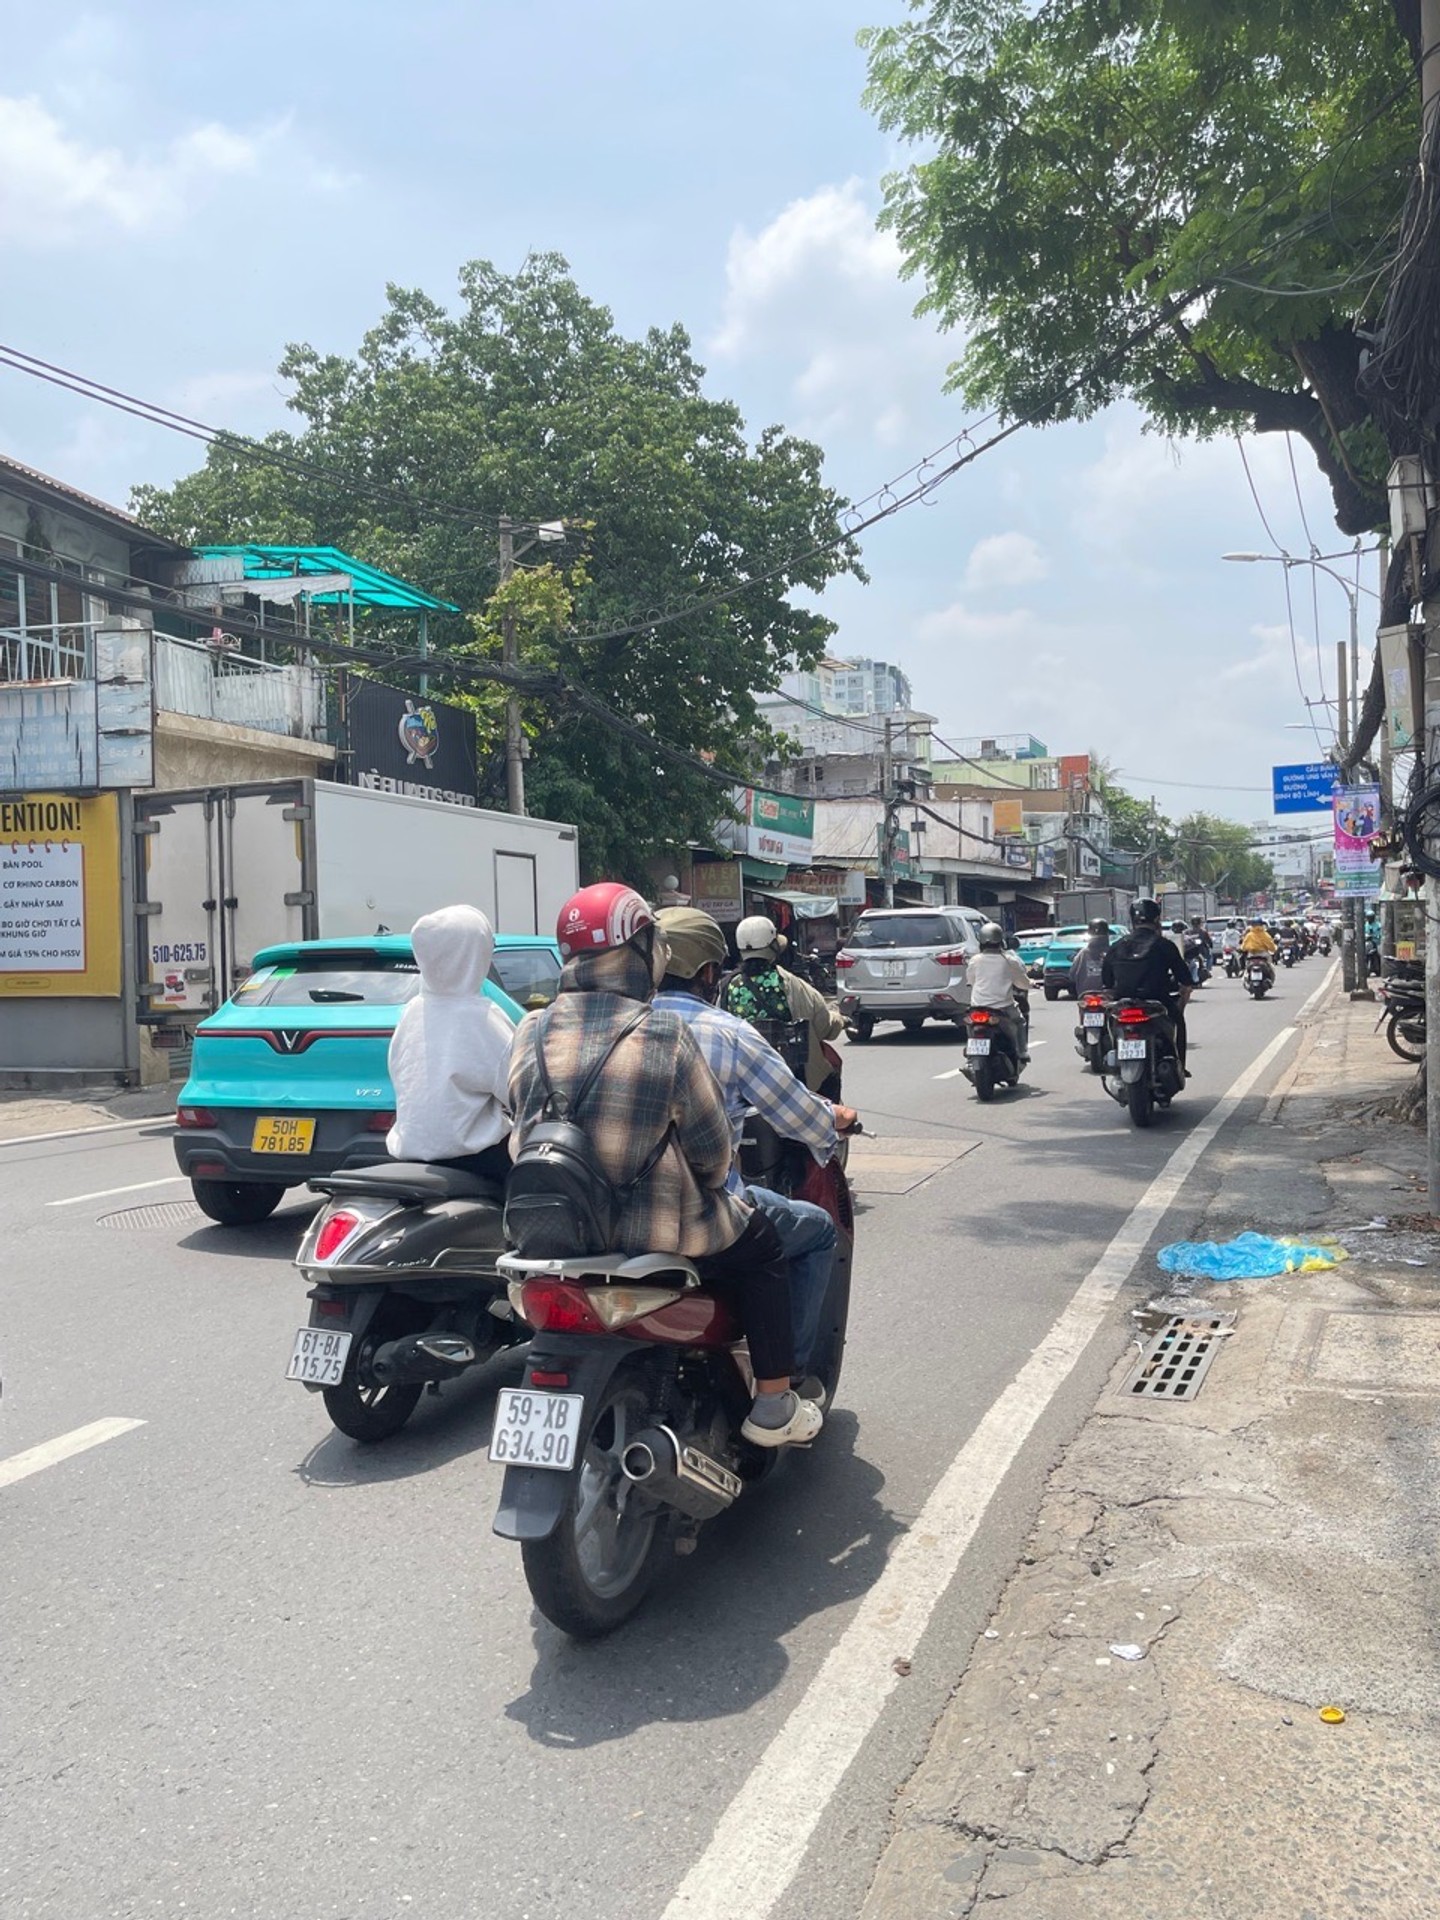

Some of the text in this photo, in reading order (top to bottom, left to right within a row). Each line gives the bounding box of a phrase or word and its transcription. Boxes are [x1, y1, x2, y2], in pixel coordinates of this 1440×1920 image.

[153, 943, 206, 963] 51D-625.75
[272, 1120, 298, 1135] 50H
[260, 1136, 306, 1152] 781.85
[301, 1332, 341, 1357] 61-BA
[292, 1355, 341, 1381] 115.75
[507, 1395, 569, 1429] 59-XB
[495, 1428, 569, 1463] 634.90
